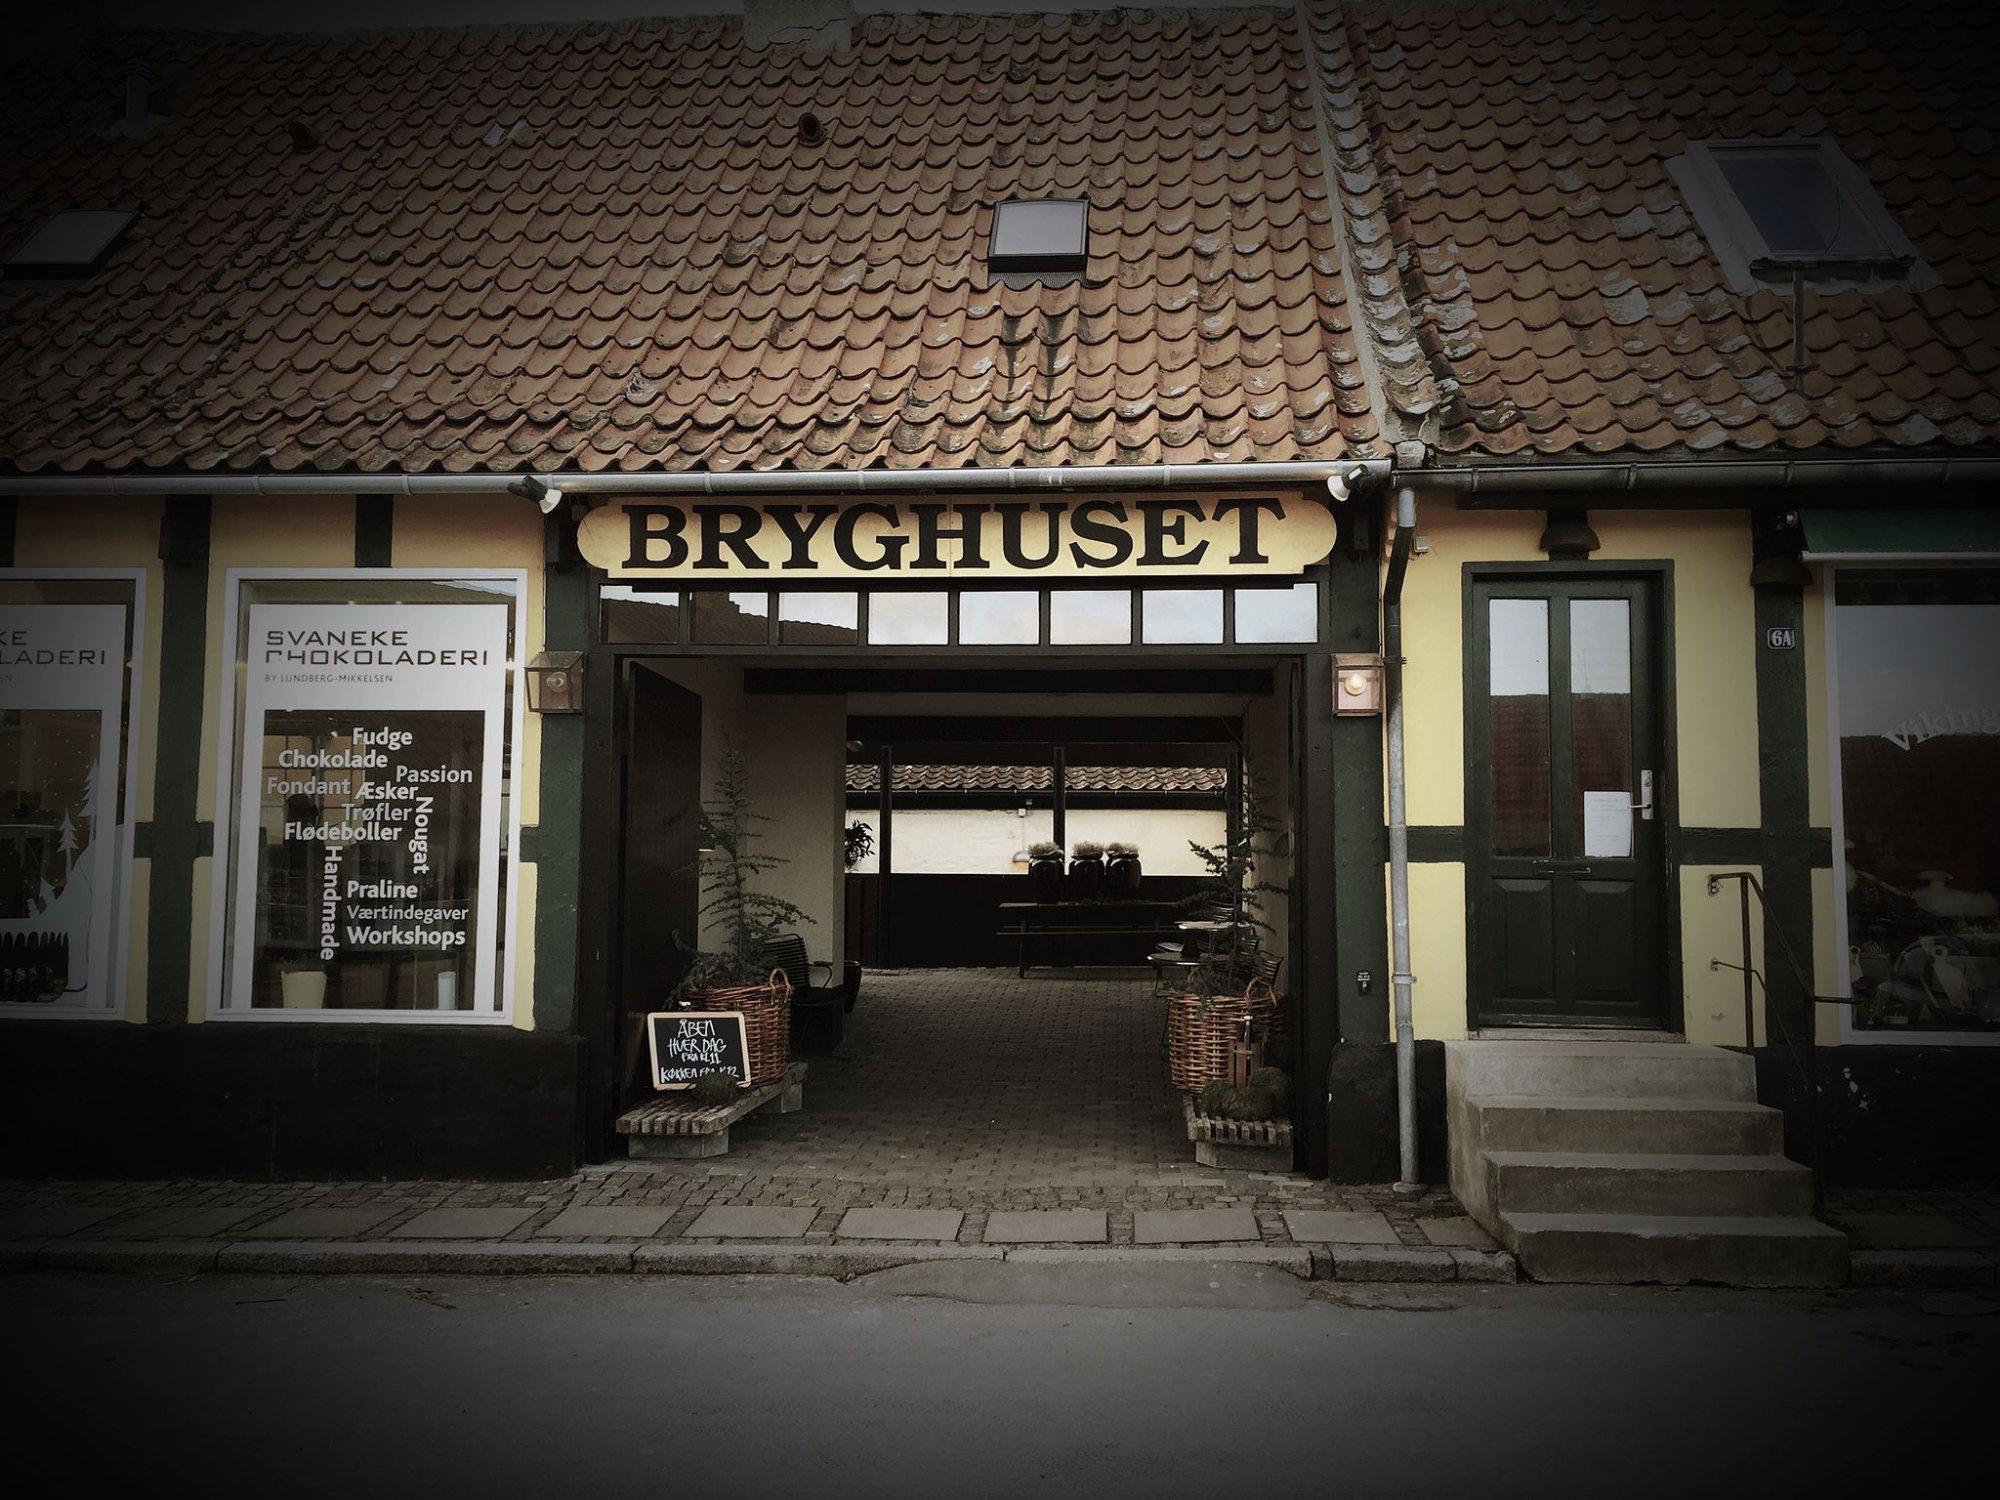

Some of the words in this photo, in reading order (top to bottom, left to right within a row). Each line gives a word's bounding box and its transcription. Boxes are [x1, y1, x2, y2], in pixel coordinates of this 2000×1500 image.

[621, 497, 1287, 570] BRYGHUSET
[266, 630, 409, 646] SVANEKE
[1771, 629, 1792, 647] 6A
[264, 674, 278, 682] BY
[281, 674, 393, 683] LUNDBERG-MIKKELSEN
[352, 726, 413, 750] Fudge
[278, 749, 389, 768] Chokolade
[396, 764, 473, 783] Passion
[267, 776, 351, 795] Fondant
[354, 781, 420, 800] Æsker
[341, 802, 413, 822] Trøfler
[284, 821, 403, 842] Flødeboller
[408, 796, 434, 875] Nougat
[346, 879, 419, 899] Praline
[319, 845, 344, 961] Handmade
[346, 904, 470, 925] Værtindegaver
[346, 924, 466, 951] Workshops
[677, 1018, 715, 1038] ÅBEN
[702, 1037, 727, 1053] DAG
